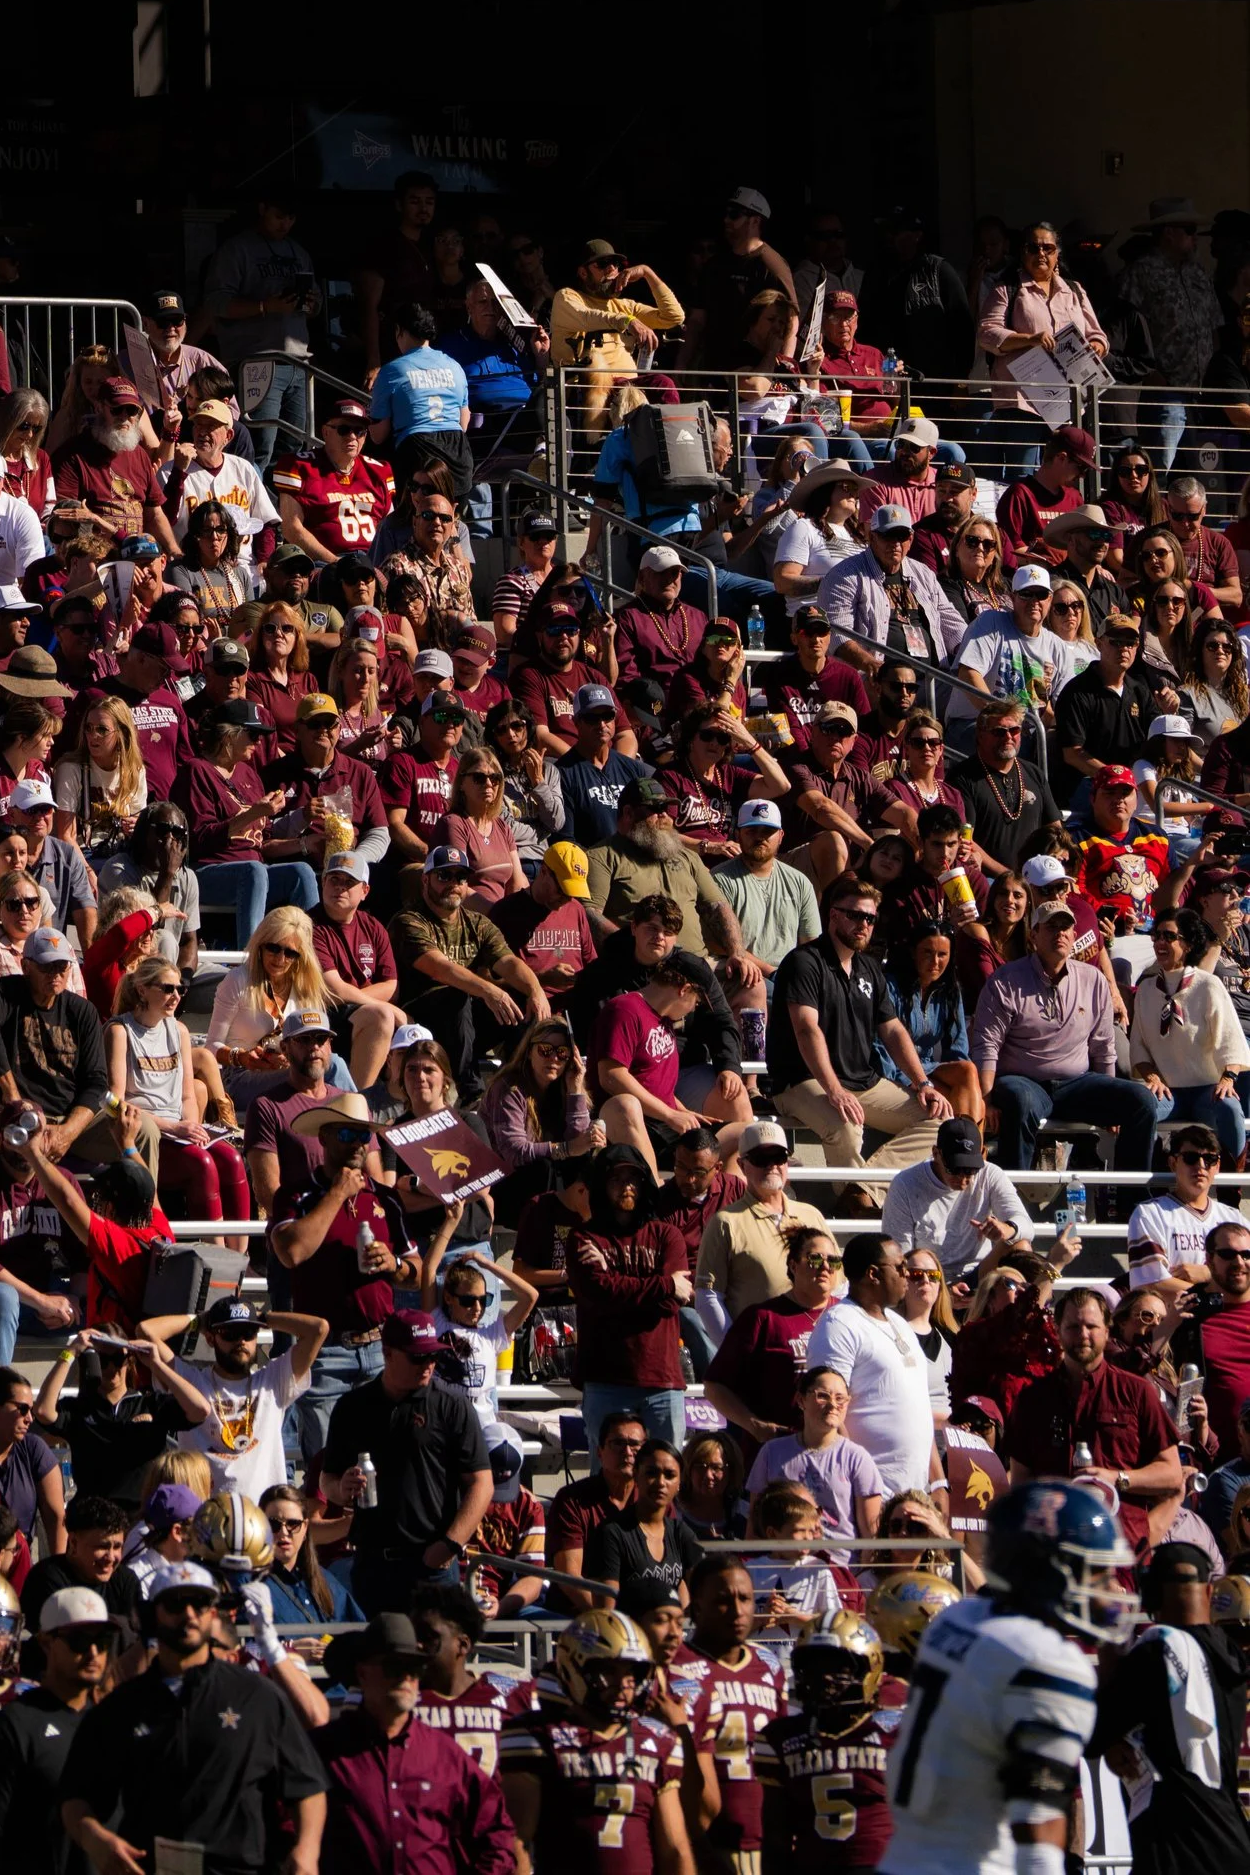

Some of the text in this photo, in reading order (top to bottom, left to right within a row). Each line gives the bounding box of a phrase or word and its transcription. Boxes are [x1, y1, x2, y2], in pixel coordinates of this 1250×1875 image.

[353, 142, 391, 158] Doritos
[410, 135, 508, 161] WALKING
[406, 369, 456, 389] VENDOR
[247, 388, 261, 398] TCU
[337, 501, 379, 543] 65
[385, 1110, 459, 1147] GO BOBCATS!
[455, 1168, 506, 1200] FOR THE BRAVE
[1172, 1232, 1207, 1253] TEXAS
[685, 1404, 719, 1424] TCU
[951, 1516, 967, 1530] BOWL
[966, 1517, 979, 1531] FOR
[454, 1705, 502, 1732] STATE
[836, 1746, 888, 1774] STATE
[595, 1783, 635, 1849] 7
[811, 1773, 858, 1842] 5
